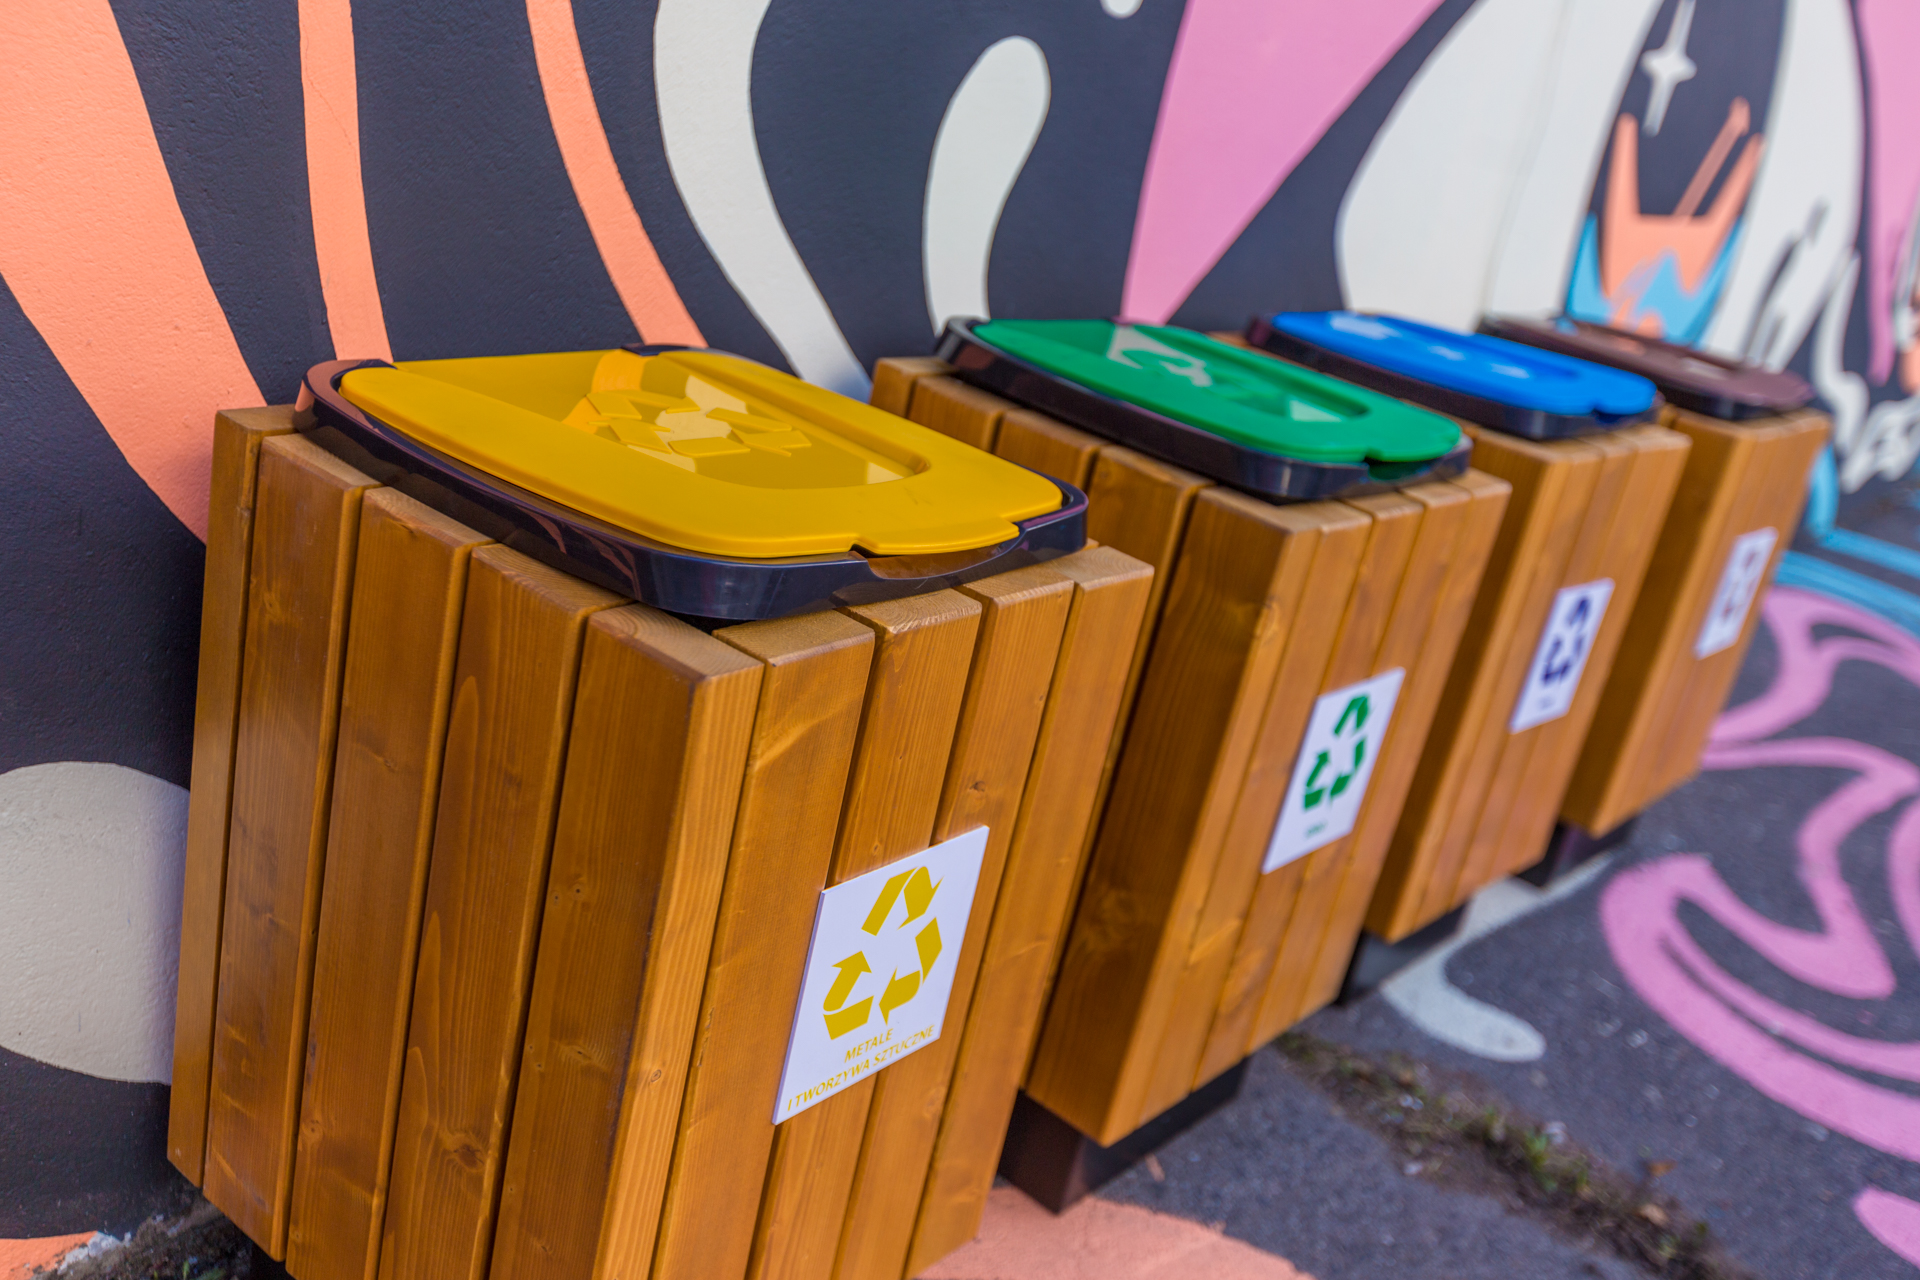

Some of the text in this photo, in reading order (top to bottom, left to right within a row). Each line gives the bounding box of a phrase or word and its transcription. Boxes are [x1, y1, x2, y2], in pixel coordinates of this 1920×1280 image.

[787, 1025, 935, 1112] I TWORZYWA SZTUCZNE
[844, 1028, 894, 1063] METALE
